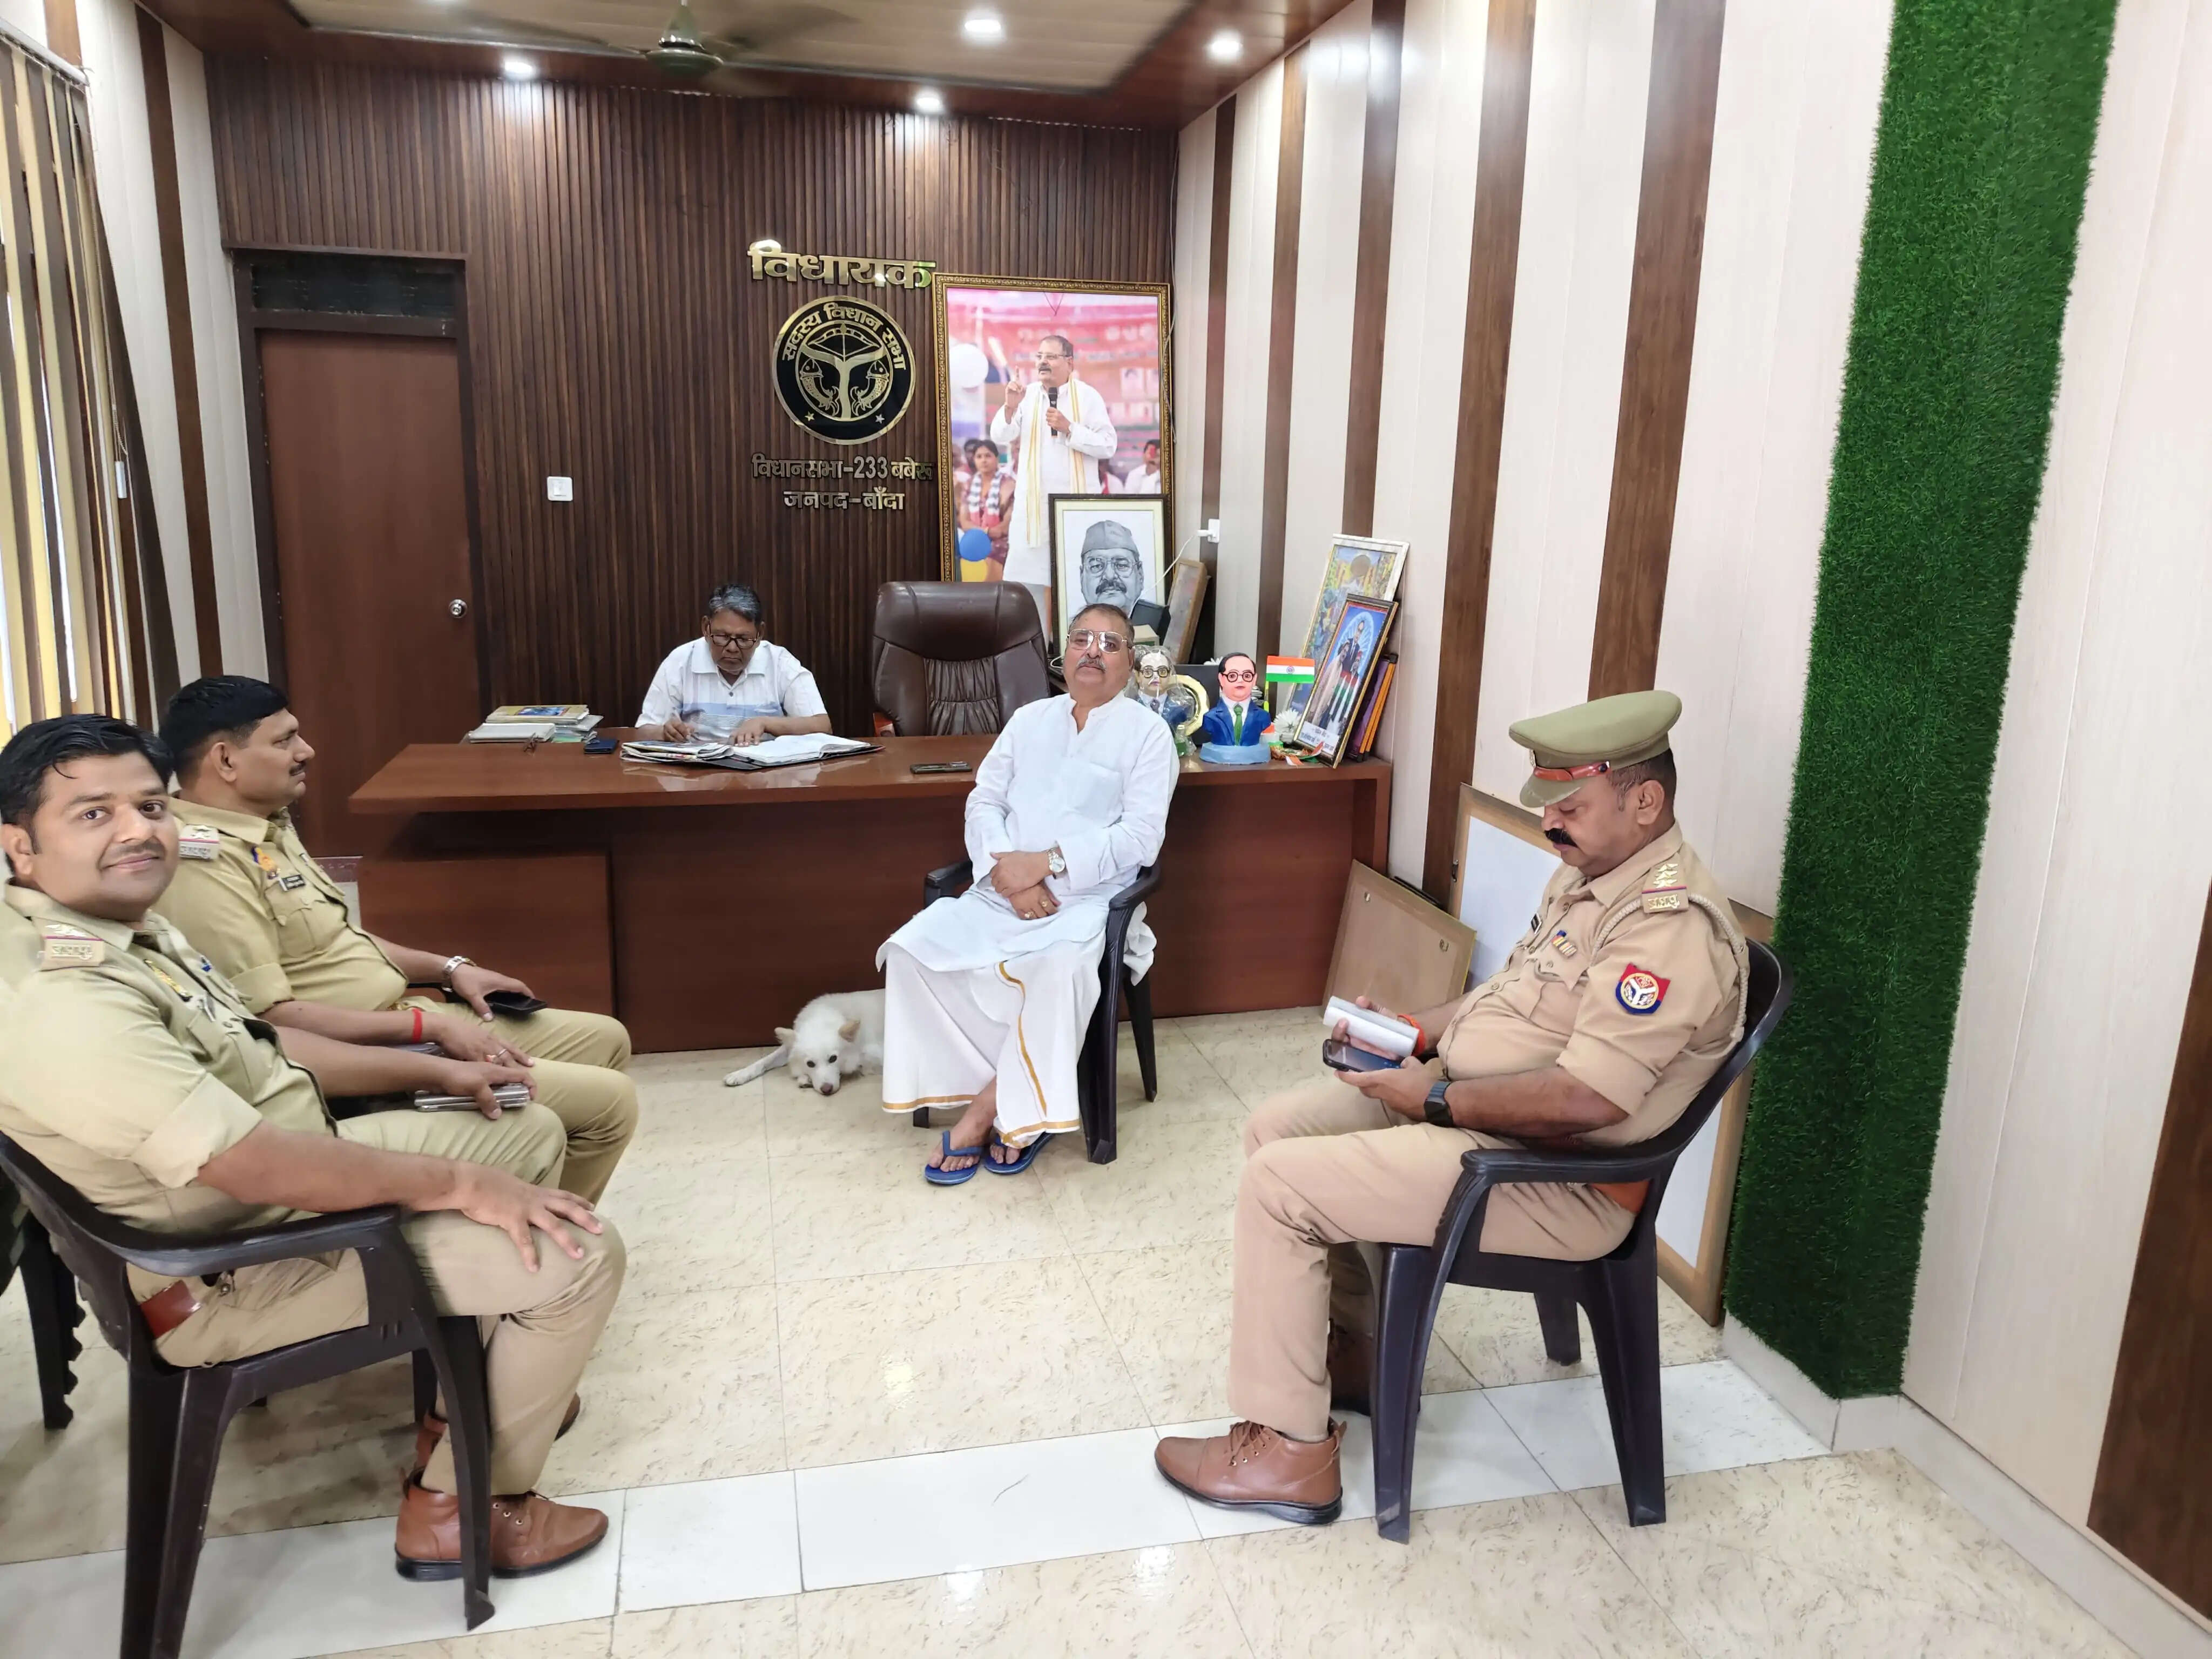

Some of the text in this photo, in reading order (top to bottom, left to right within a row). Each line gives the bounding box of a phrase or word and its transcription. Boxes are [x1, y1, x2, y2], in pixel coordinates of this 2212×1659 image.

[747, 239, 936, 289] विधायक
[782, 302, 907, 370] सदस्य विधान सभा
